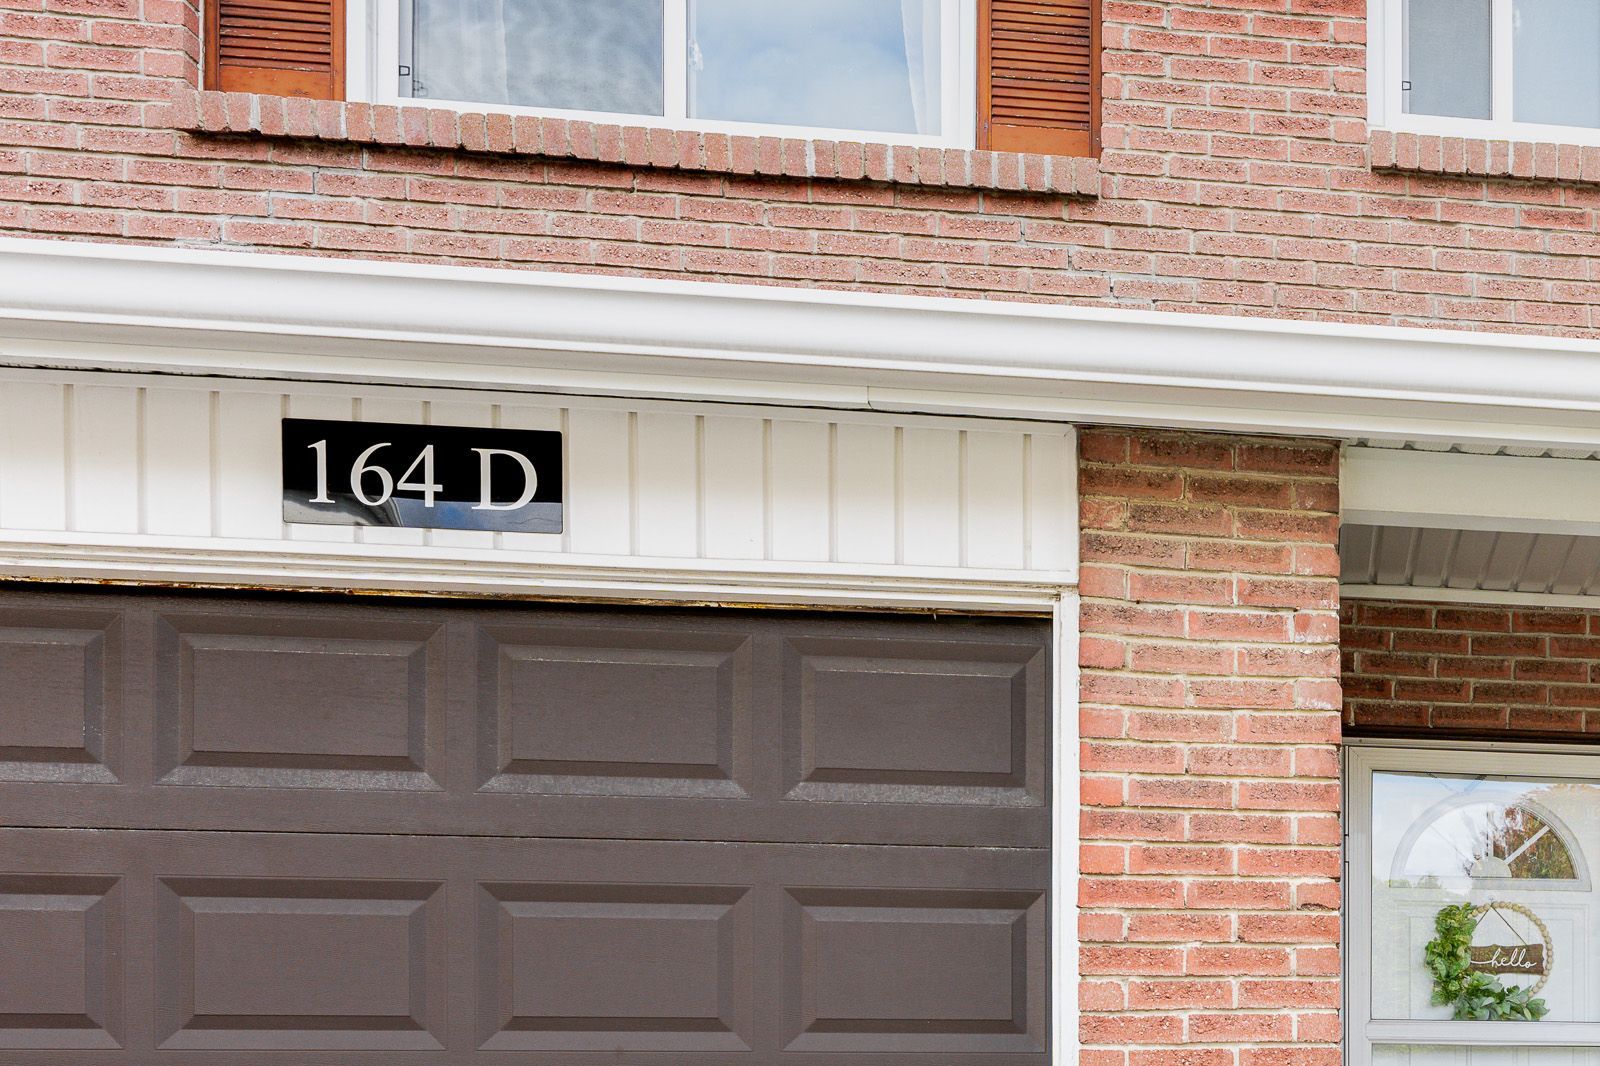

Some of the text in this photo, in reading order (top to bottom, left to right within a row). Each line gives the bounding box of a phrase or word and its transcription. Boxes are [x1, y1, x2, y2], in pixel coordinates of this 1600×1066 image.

[307, 440, 538, 510] 164 D
[1471, 948, 1537, 968] hello
